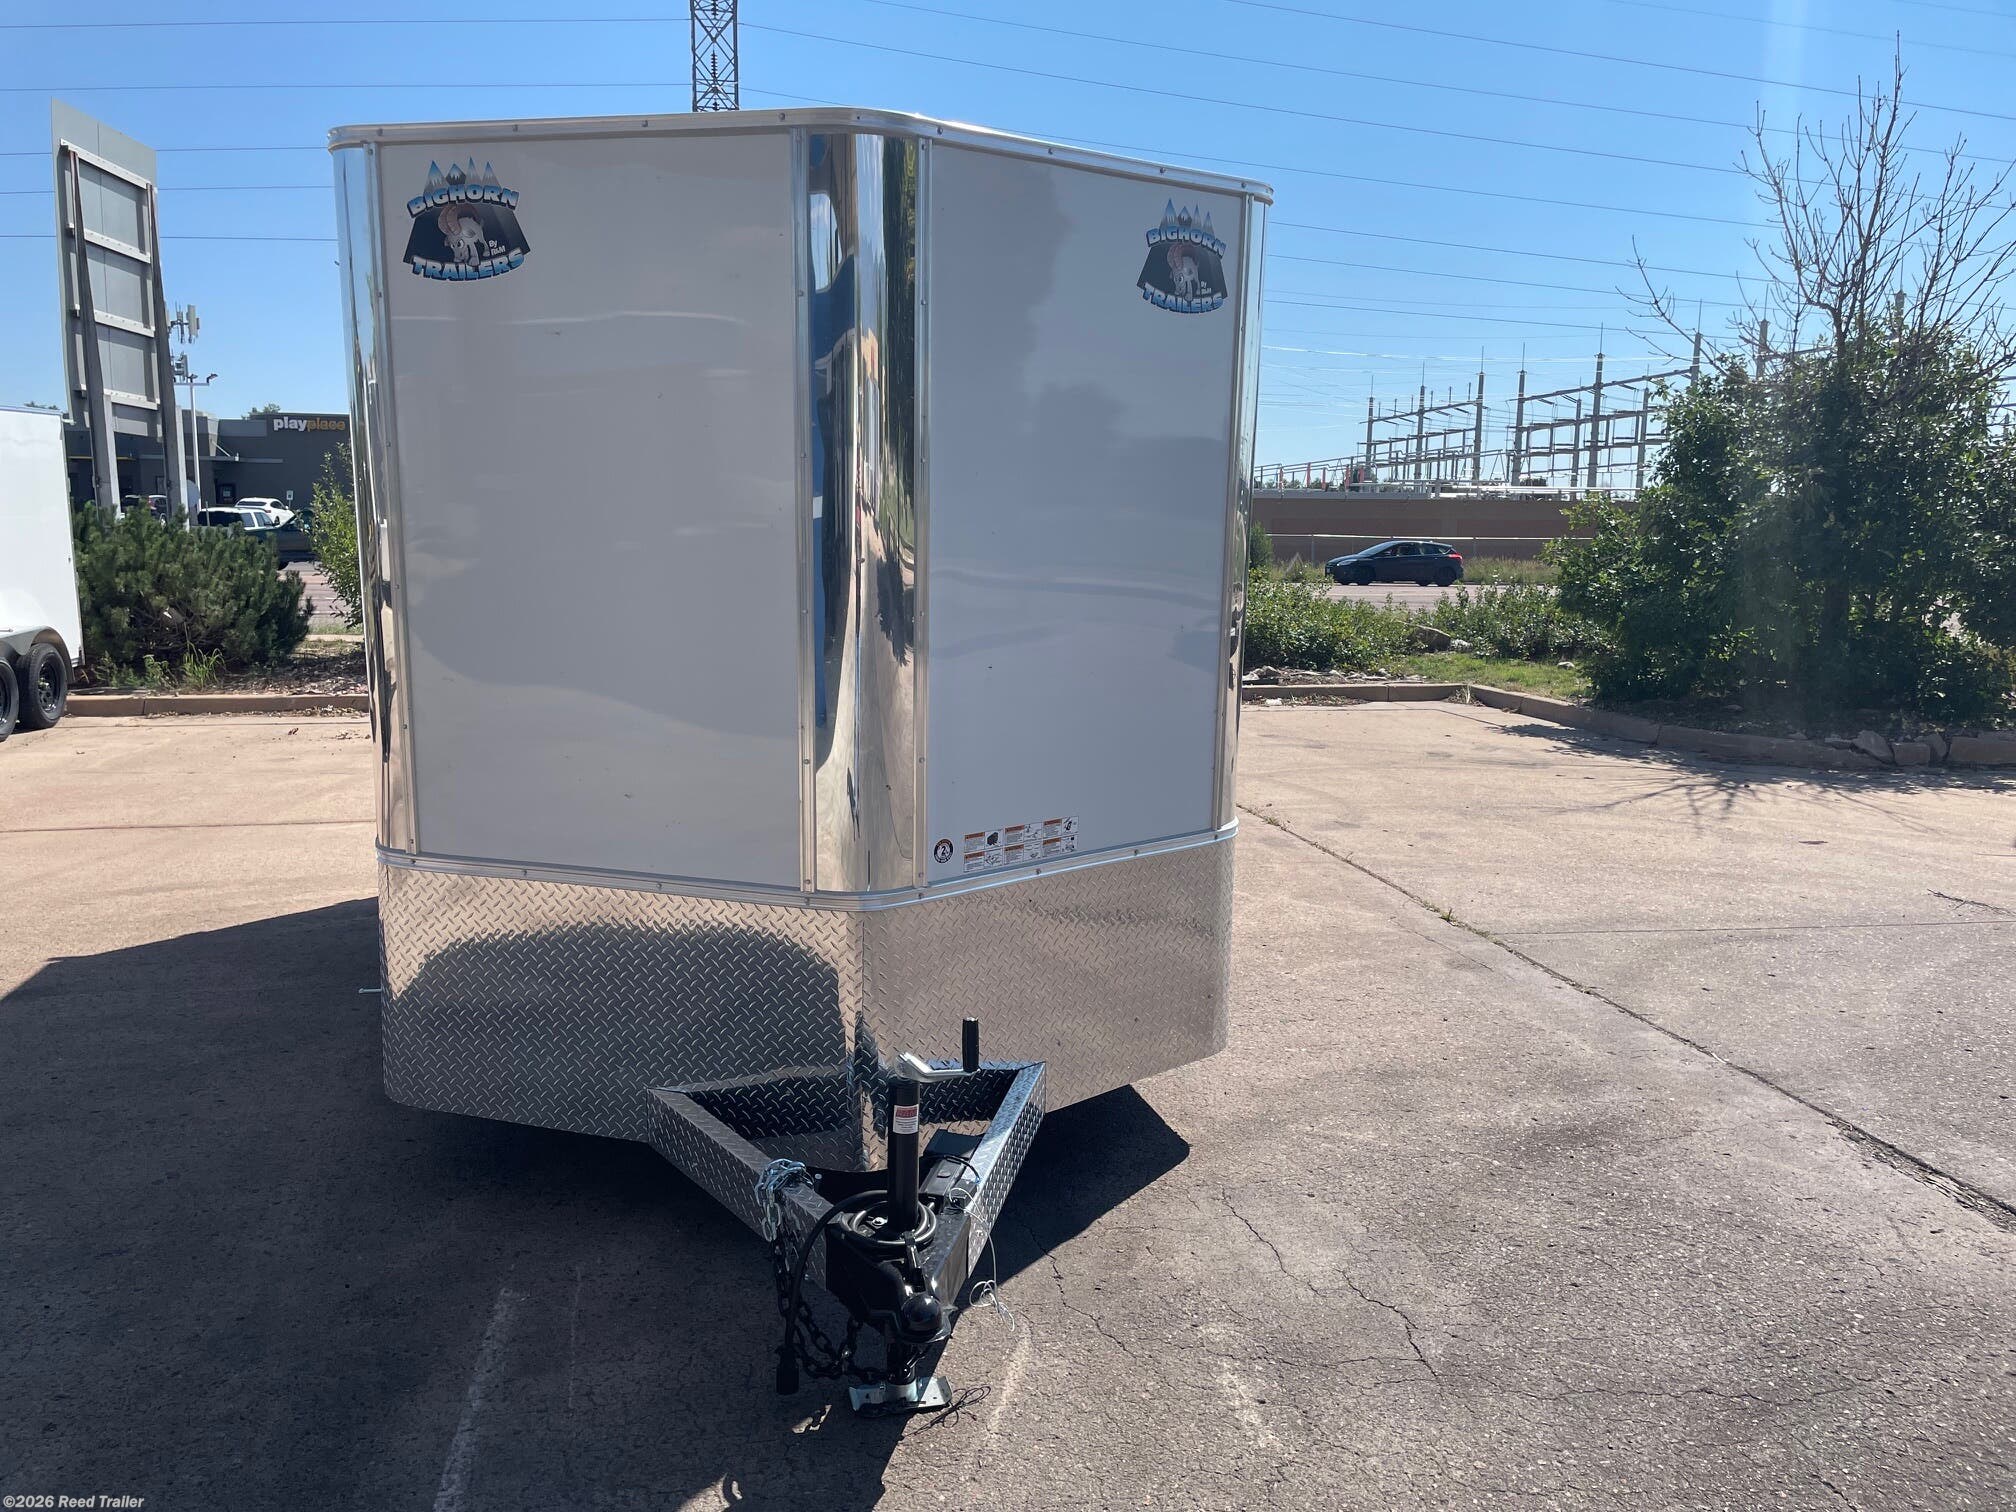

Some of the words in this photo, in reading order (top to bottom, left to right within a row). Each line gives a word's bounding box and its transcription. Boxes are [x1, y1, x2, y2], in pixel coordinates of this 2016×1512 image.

[407, 184, 520, 218] BIGHORN
[1146, 226, 1227, 260] BIGHORN
[411, 249, 525, 281] TRAILERS
[1142, 282, 1224, 313] TRAILERS
